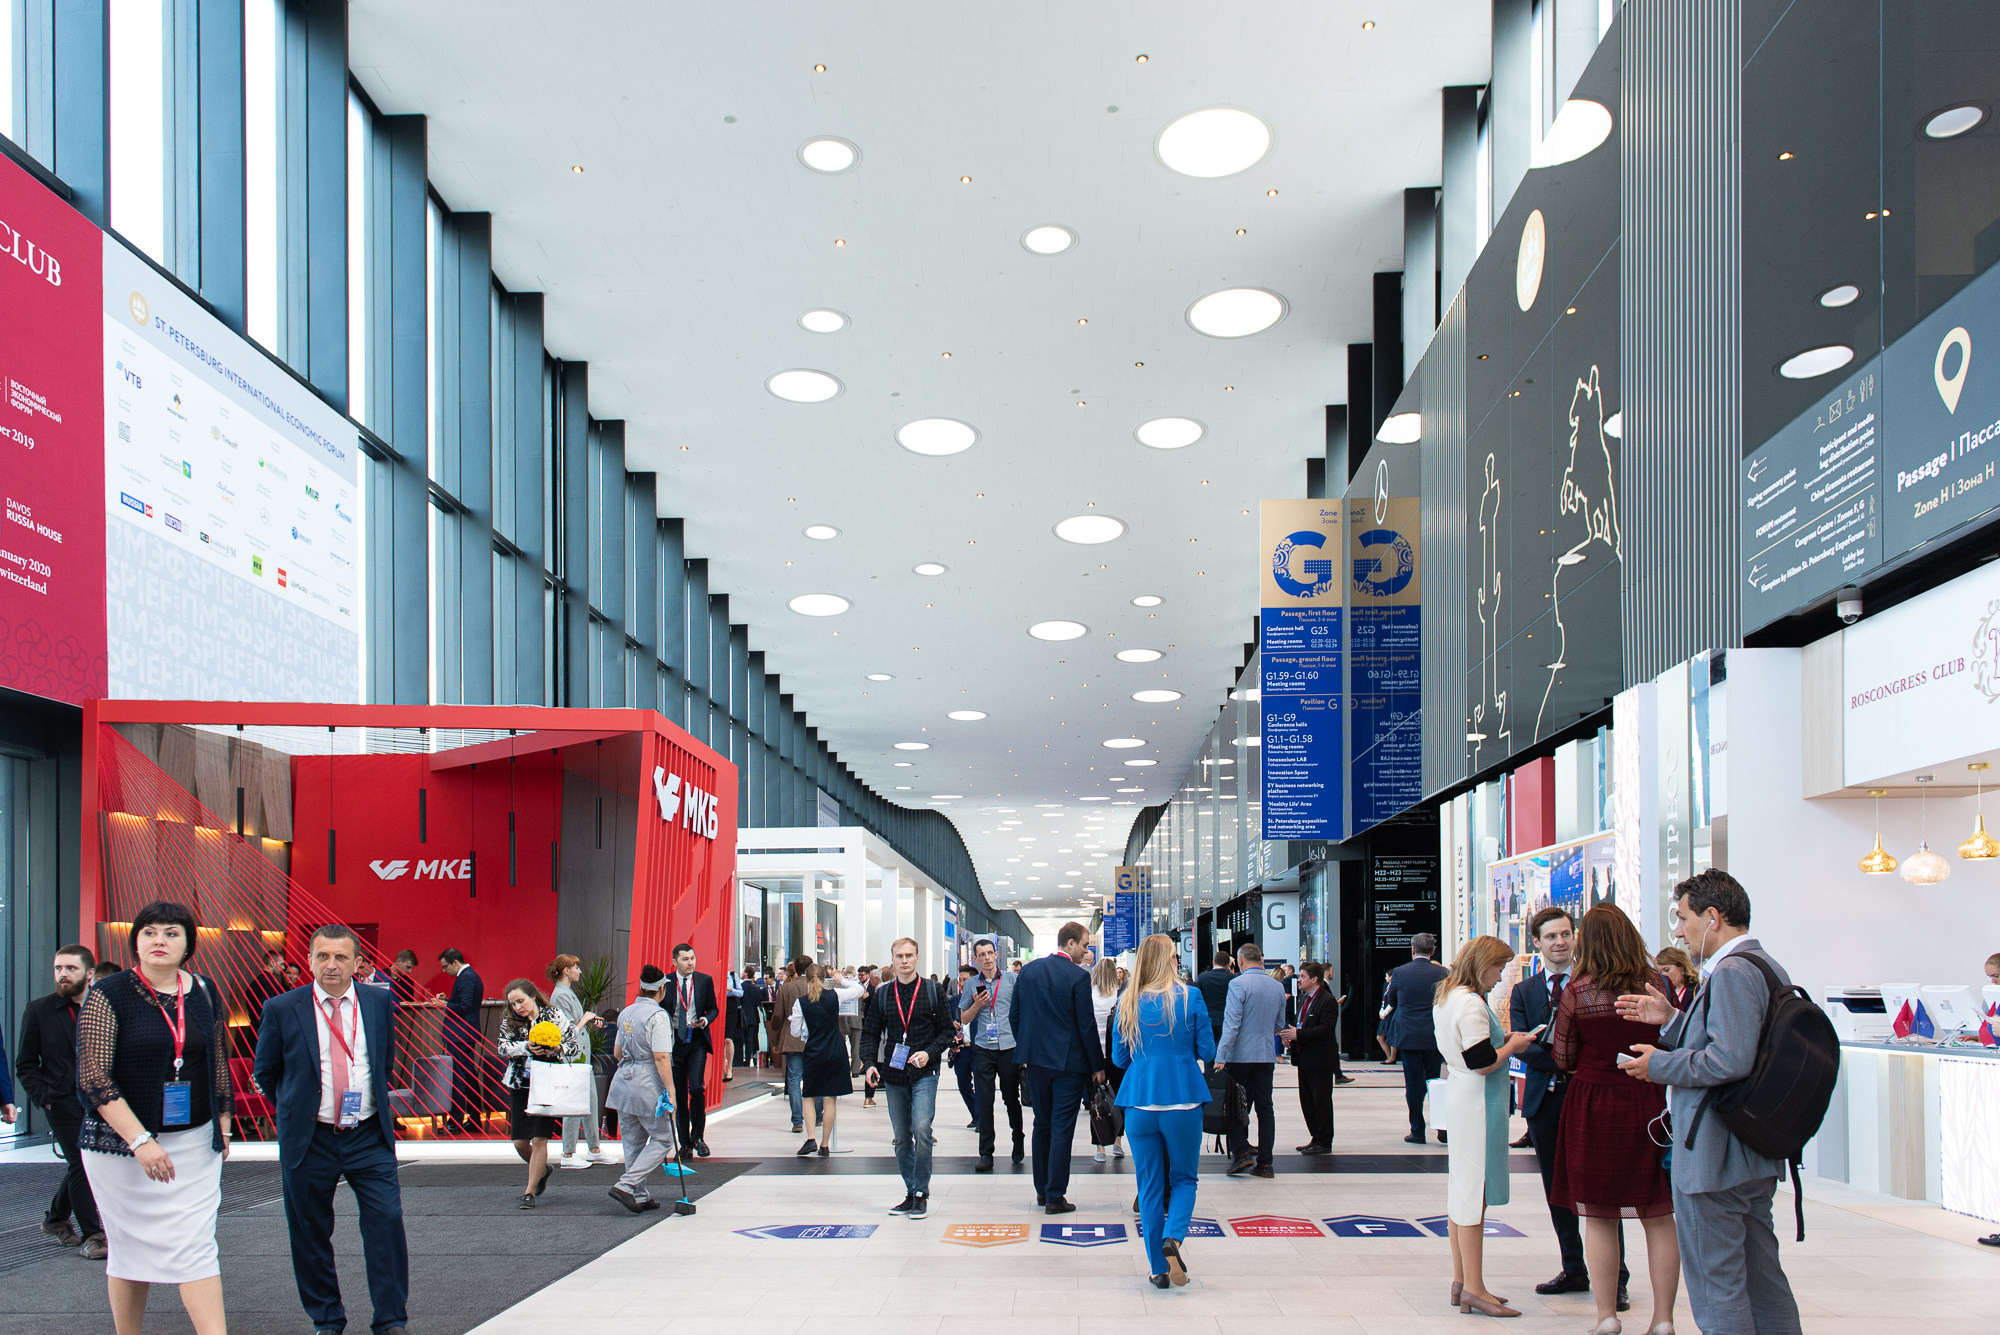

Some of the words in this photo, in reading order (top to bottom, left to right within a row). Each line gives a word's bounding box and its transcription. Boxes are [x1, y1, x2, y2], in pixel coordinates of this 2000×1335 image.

[10, 379, 47, 406] ВОСТОЧНЫЙ
[124, 367, 142, 389] VTB
[155, 316, 168, 335] ST.
[169, 326, 223, 374] PETERSBURG
[224, 367, 286, 420] INTERNATIONAL
[286, 411, 323, 447] ECONOMIC
[323, 439, 346, 463] FORUM
[10, 388, 62, 424] ЭКОНОМИЧЕСКИЙ
[10, 398, 33, 417] ФОРУМ
[12, 429, 35, 450] 2019
[1819, 432, 1847, 456] Participant
[1847, 422, 1857, 437] and
[1857, 413, 1875, 430] media
[1819, 459, 1829, 470] bag
[1829, 438, 1859, 463] distribution
[1859, 426, 1875, 445] point
[1747, 491, 1763, 507] Signing
[1784, 467, 1797, 484] point
[1810, 489, 1825, 502] China
[1825, 474, 1847, 493] Gramota
[1847, 455, 1875, 479] restaurant
[1897, 452, 1948, 493] Passage
[6, 497, 32, 517] DAVOS
[1913, 497, 1939, 519] Zone
[1940, 486, 1949, 504] H
[1957, 472, 1983, 495] Зона
[6, 509, 35, 531] RUSSIA
[36, 523, 63, 544] HOUSE
[1755, 519, 1774, 538] FORUM
[1774, 506, 1797, 527] restaurant
[1794, 530, 1817, 548] Congress
[1817, 520, 1834, 535] Centre
[1836, 508, 1853, 523] Zones
[1859, 499, 1865, 510] G
[28, 558, 52, 578] 2020
[1272, 530, 1332, 598] G
[1760, 577, 1781, 593] Hampton
[1780, 573, 1787, 583] by
[1786, 565, 1802, 579] Hilton
[1801, 560, 1809, 571] St.
[1808, 546, 1836, 566] Petersburg
[1835, 529, 1865, 552] ExpoForum
[1842, 552, 1857, 565] Lobby
[1856, 547, 1865, 557] bar
[1310, 626, 1329, 635] G25
[1271, 656, 1298, 664] Passage,
[1850, 670, 1928, 709] ROSCONGRESS
[1932, 657, 1965, 680] CLUB
[1266, 713, 1296, 722] G1–G9
[1328, 698, 1338, 710] G
[1266, 735, 1313, 744] G1.1–G1.58
[682, 781, 719, 840] МКБ
[1118, 874, 1132, 890] G
[1266, 902, 1286, 931] G
[1354, 1224, 1388, 1234] F
